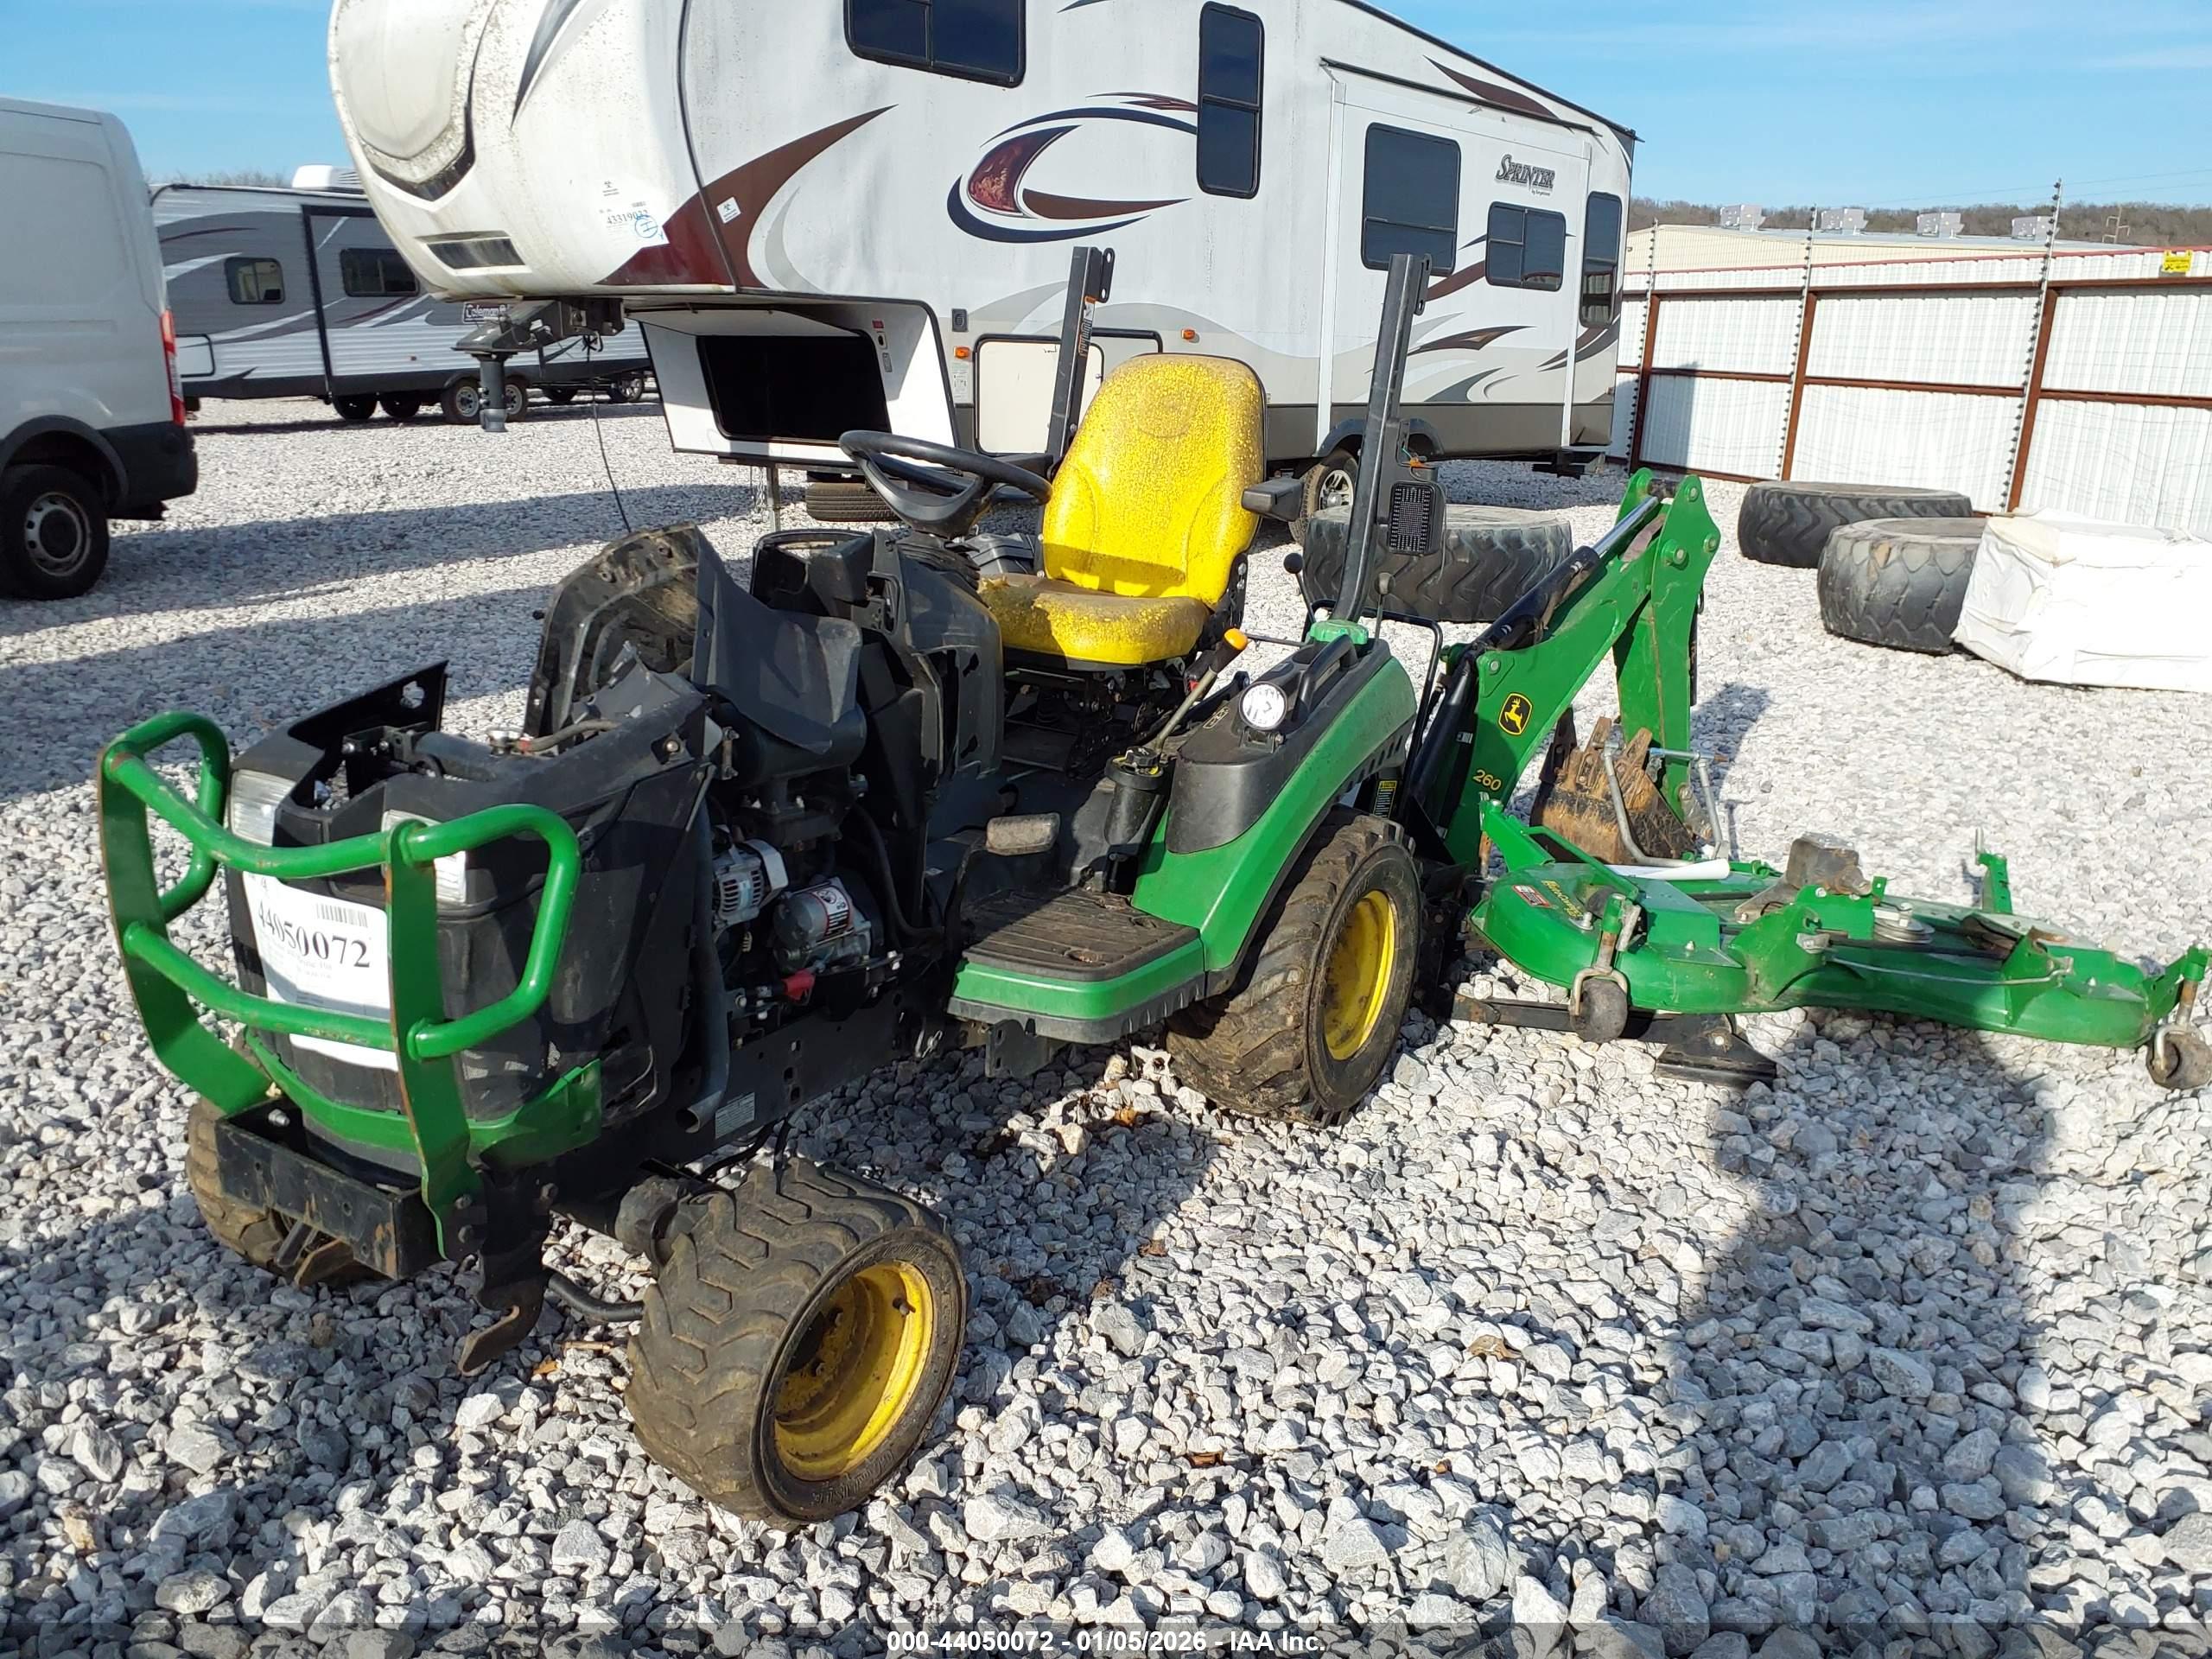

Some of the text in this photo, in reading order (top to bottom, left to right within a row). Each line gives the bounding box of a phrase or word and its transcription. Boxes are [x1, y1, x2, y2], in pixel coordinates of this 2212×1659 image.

[467, 304, 499, 318] Coleman
[1472, 769, 1502, 791] 260
[258, 900, 370, 968] 44050072
